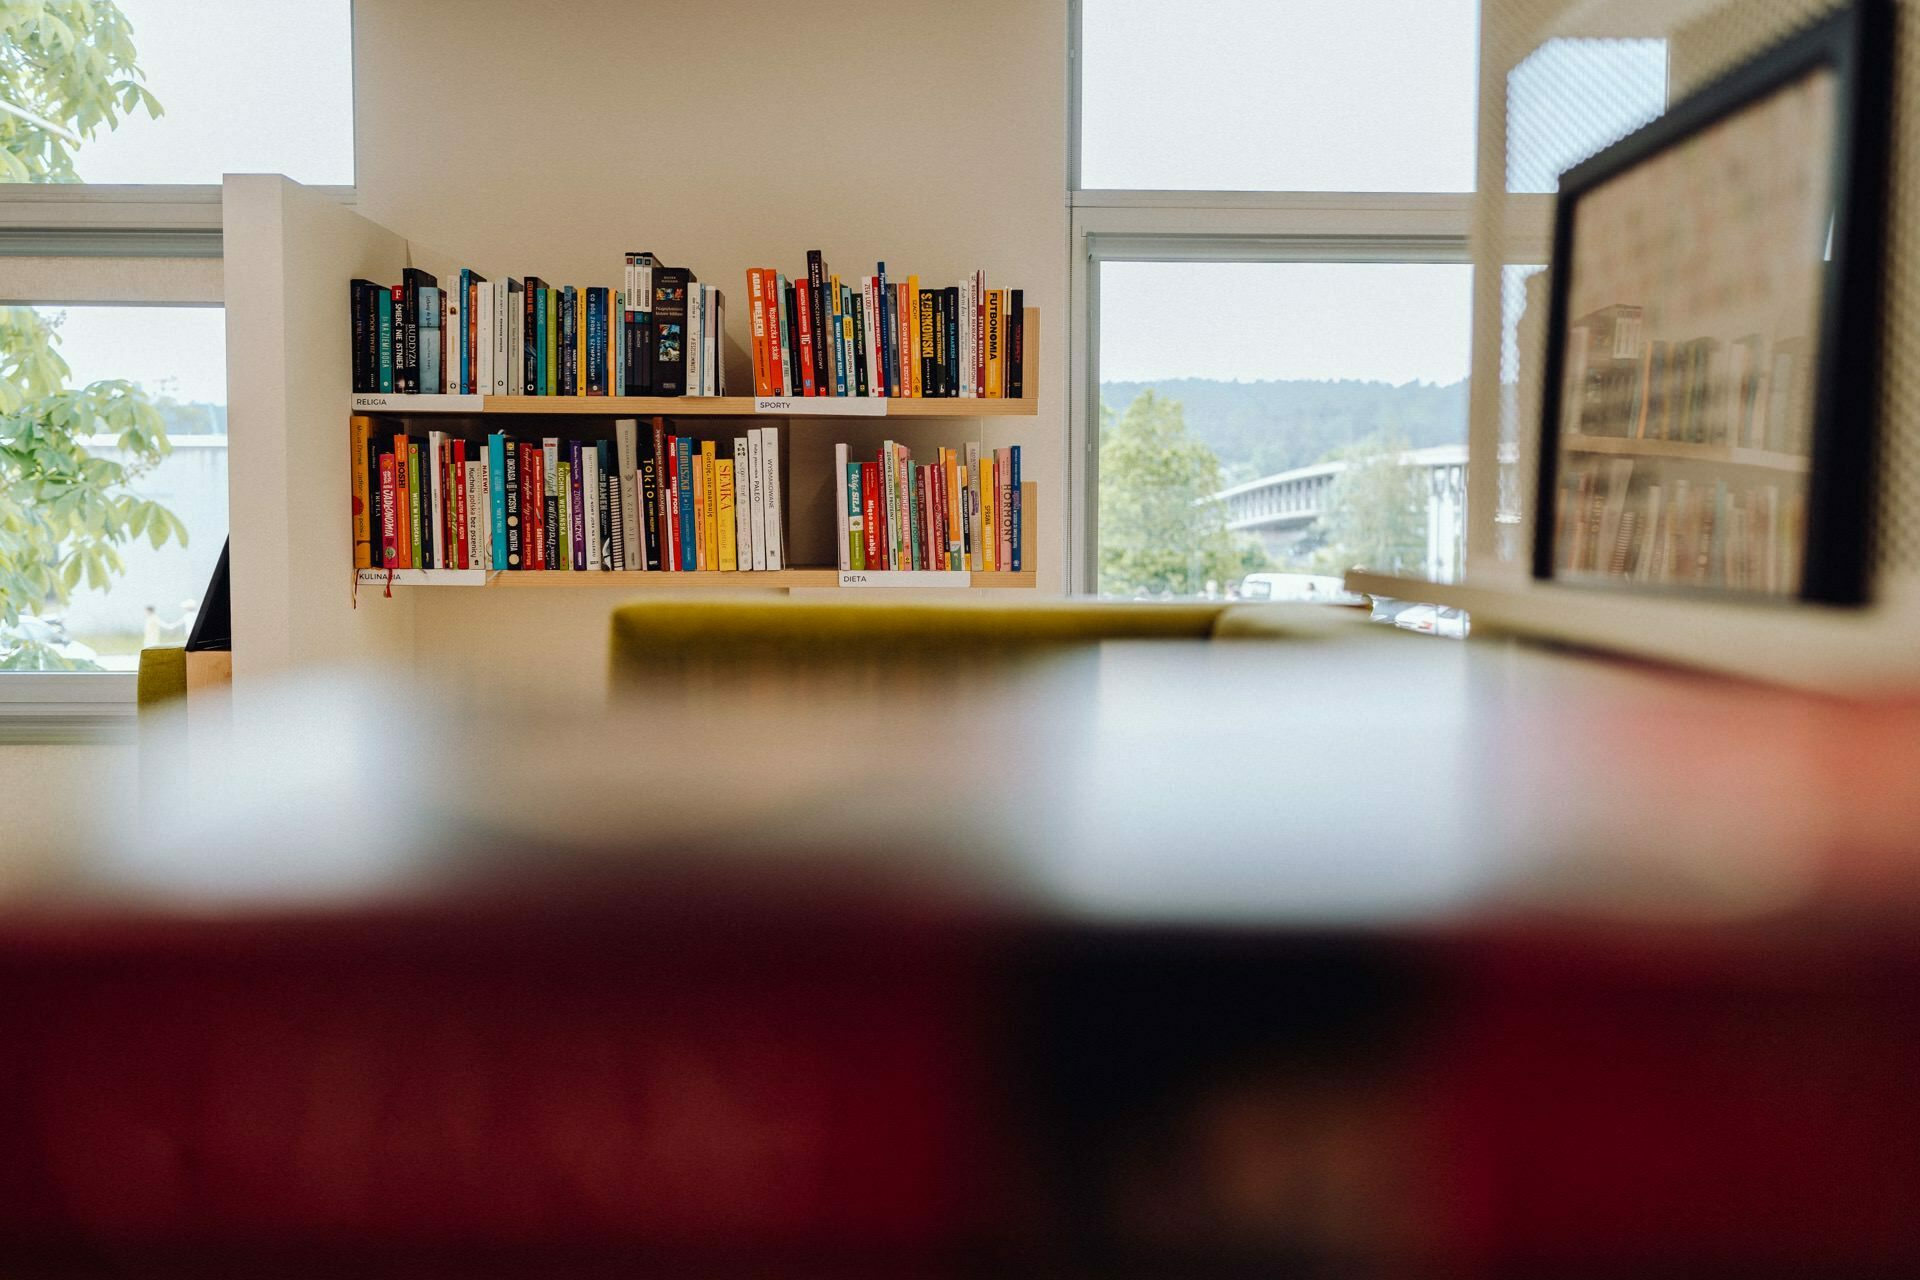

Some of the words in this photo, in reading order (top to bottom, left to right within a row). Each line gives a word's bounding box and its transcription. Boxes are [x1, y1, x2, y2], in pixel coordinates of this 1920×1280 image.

[752, 273, 762, 297] ADAM
[395, 304, 404, 326] ŚMIERĆ
[754, 301, 764, 336] BIELECKI
[768, 307, 777, 338] Wspinaczka
[972, 309, 975, 317] OD
[904, 356, 908, 364] NA
[643, 458, 654, 499] Tokio
[719, 465, 731, 511] SEMKA
[383, 490, 394, 536] JADŁONOMIA
[1003, 484, 1012, 543] HORMONY
